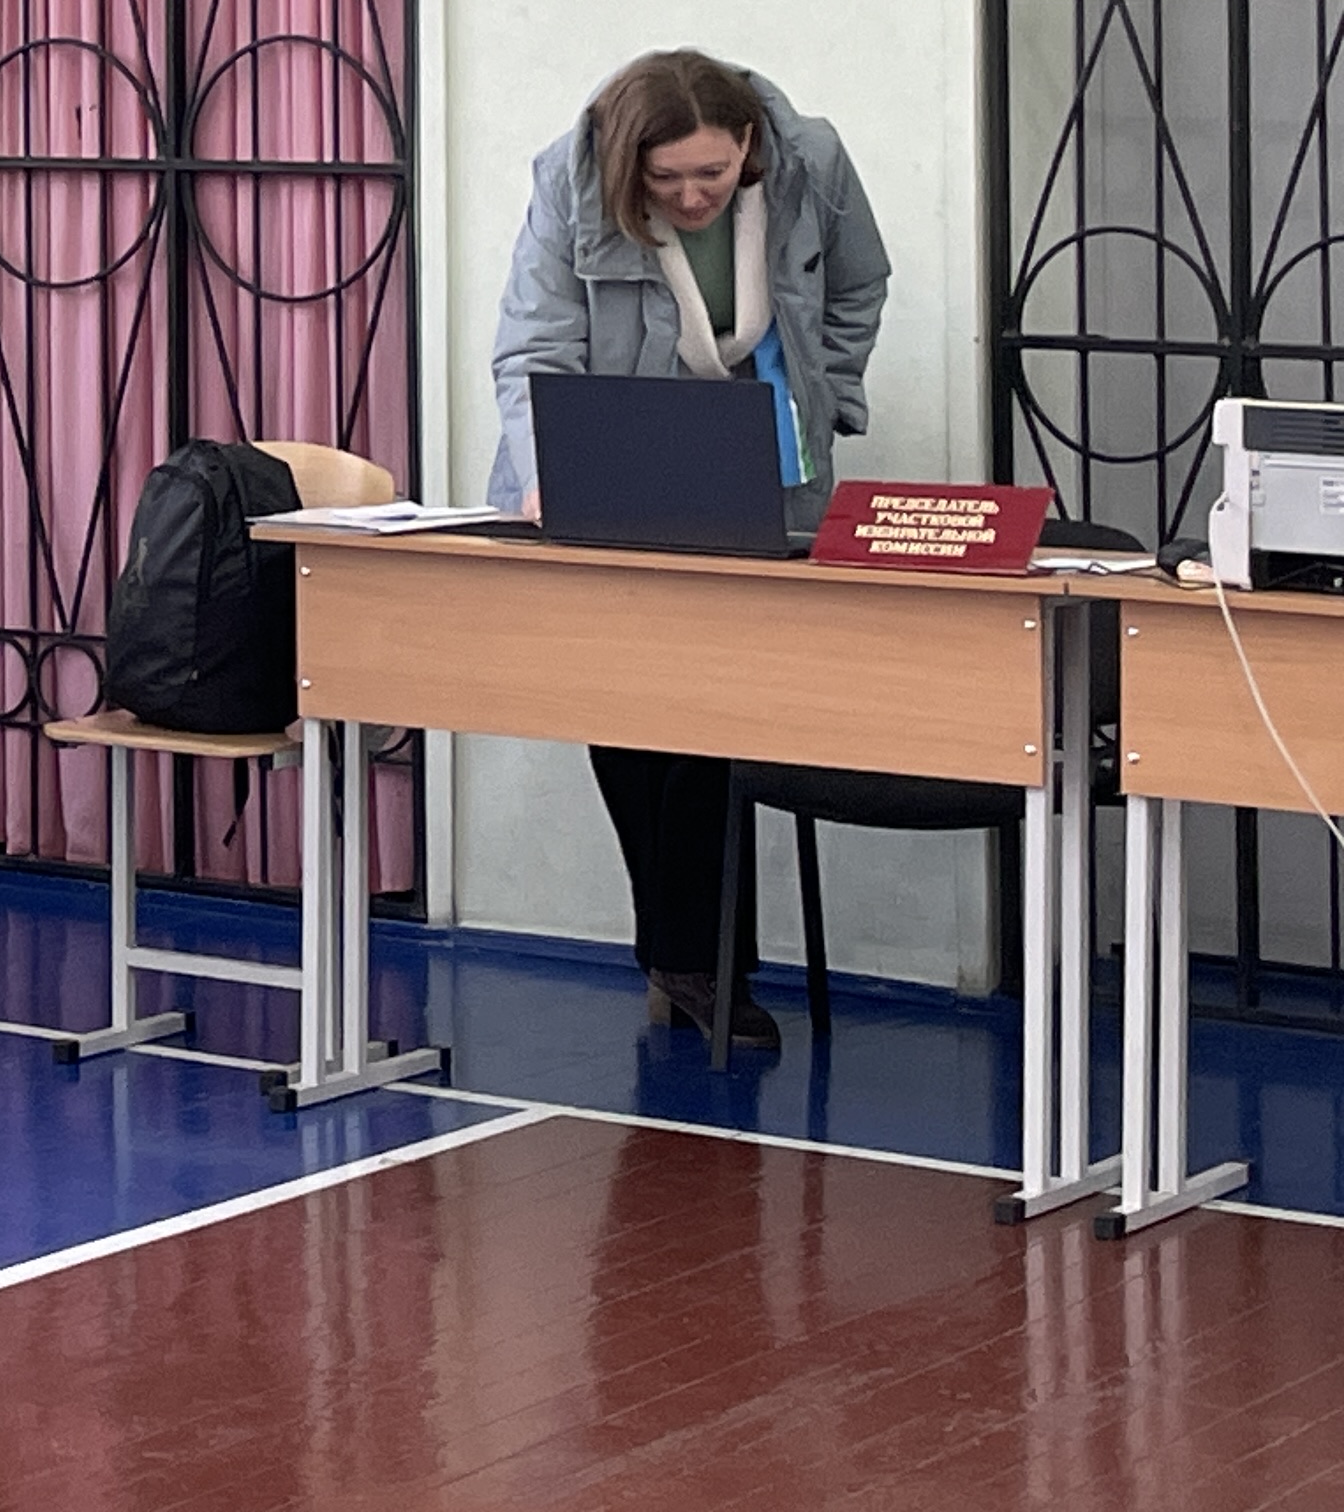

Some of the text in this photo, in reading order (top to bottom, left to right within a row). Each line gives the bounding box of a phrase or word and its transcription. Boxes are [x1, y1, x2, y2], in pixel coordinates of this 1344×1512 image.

[870, 494, 1000, 516] ПРЕДСЕДАТЕЛЬ
[874, 511, 985, 529] УЧАСТКОВОЙ
[854, 524, 997, 544] ИЗБИРАТЕЛЬНОЙ
[868, 540, 967, 558] КОМИССИИ
